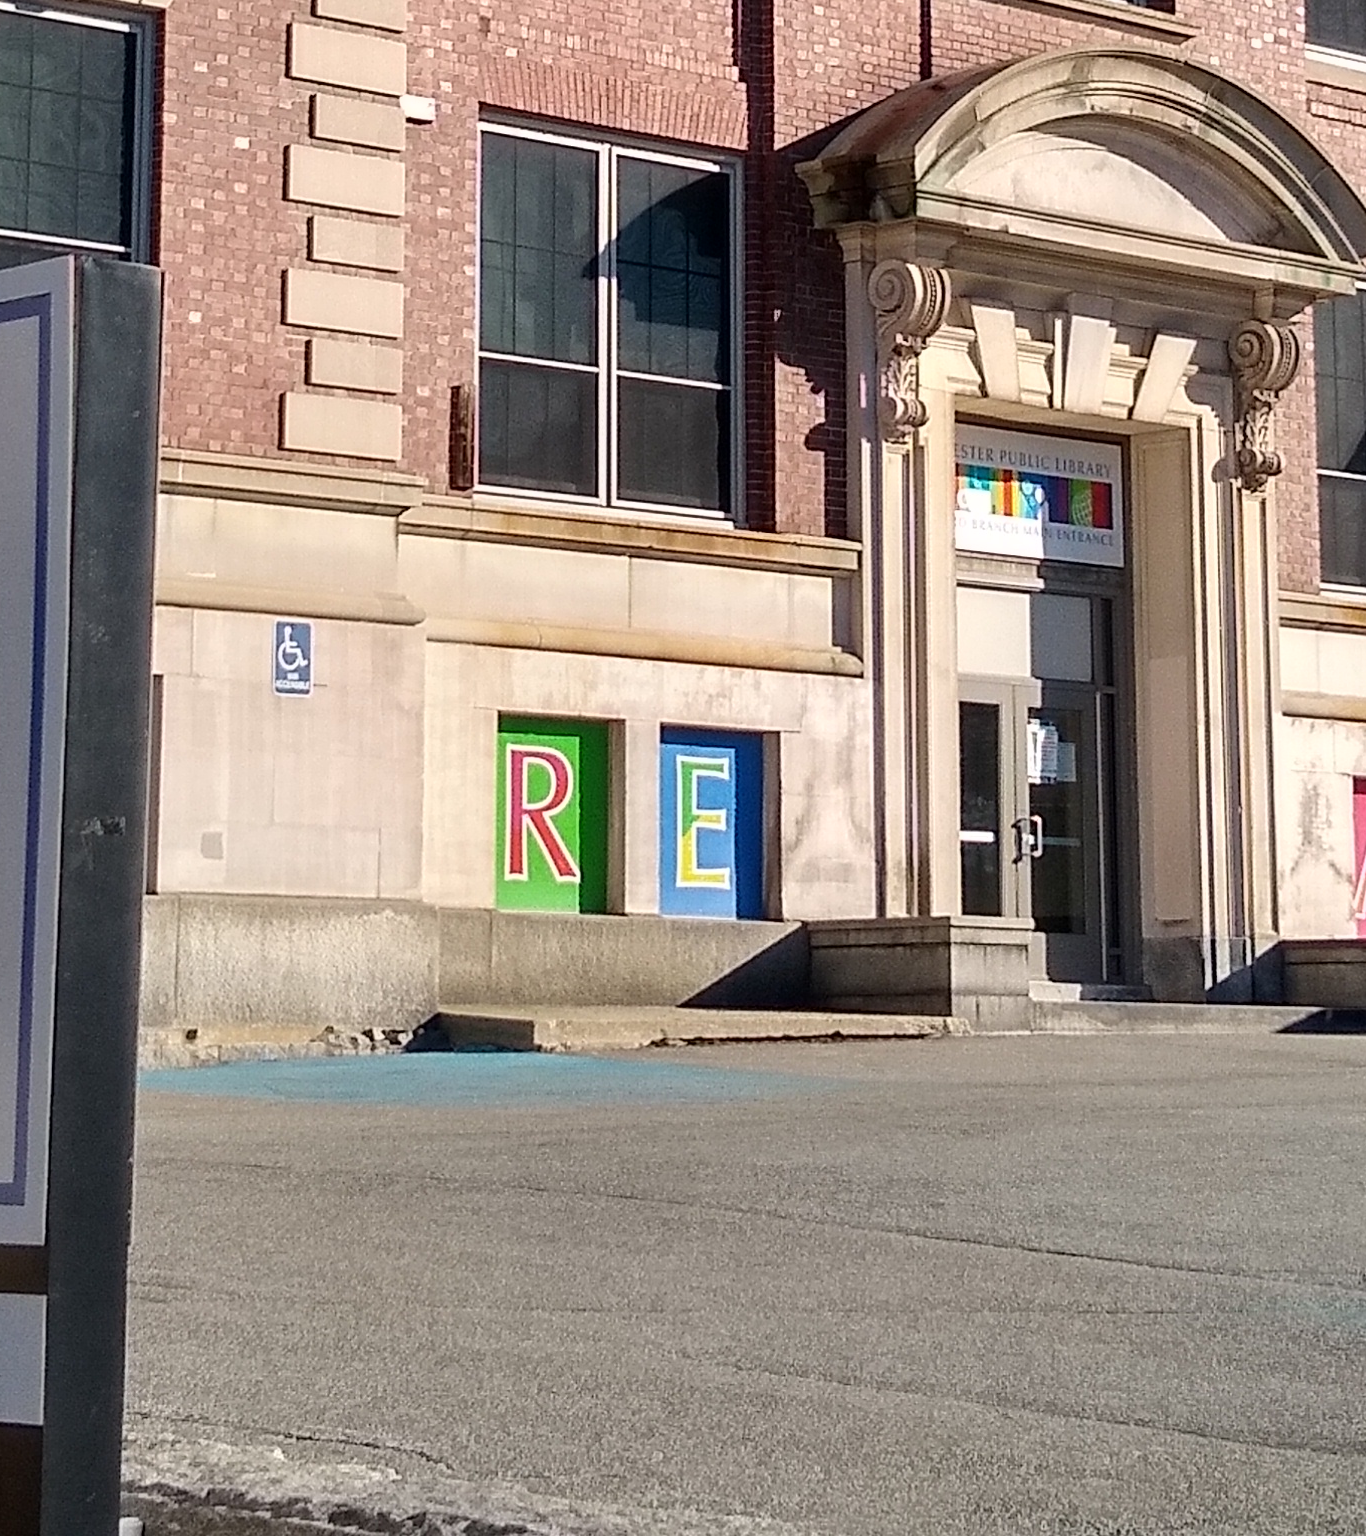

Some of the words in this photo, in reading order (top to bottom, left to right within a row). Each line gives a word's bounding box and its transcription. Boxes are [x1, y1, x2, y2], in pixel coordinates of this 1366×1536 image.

[955, 444, 994, 462] ESTER
[999, 450, 1051, 469] PUBLIC
[1055, 457, 1111, 478] LIBRARY
[971, 520, 1019, 535] BRANCH
[1057, 529, 1114, 547] ENTRANCE
[504, 742, 581, 882] R
[676, 755, 731, 889] E
